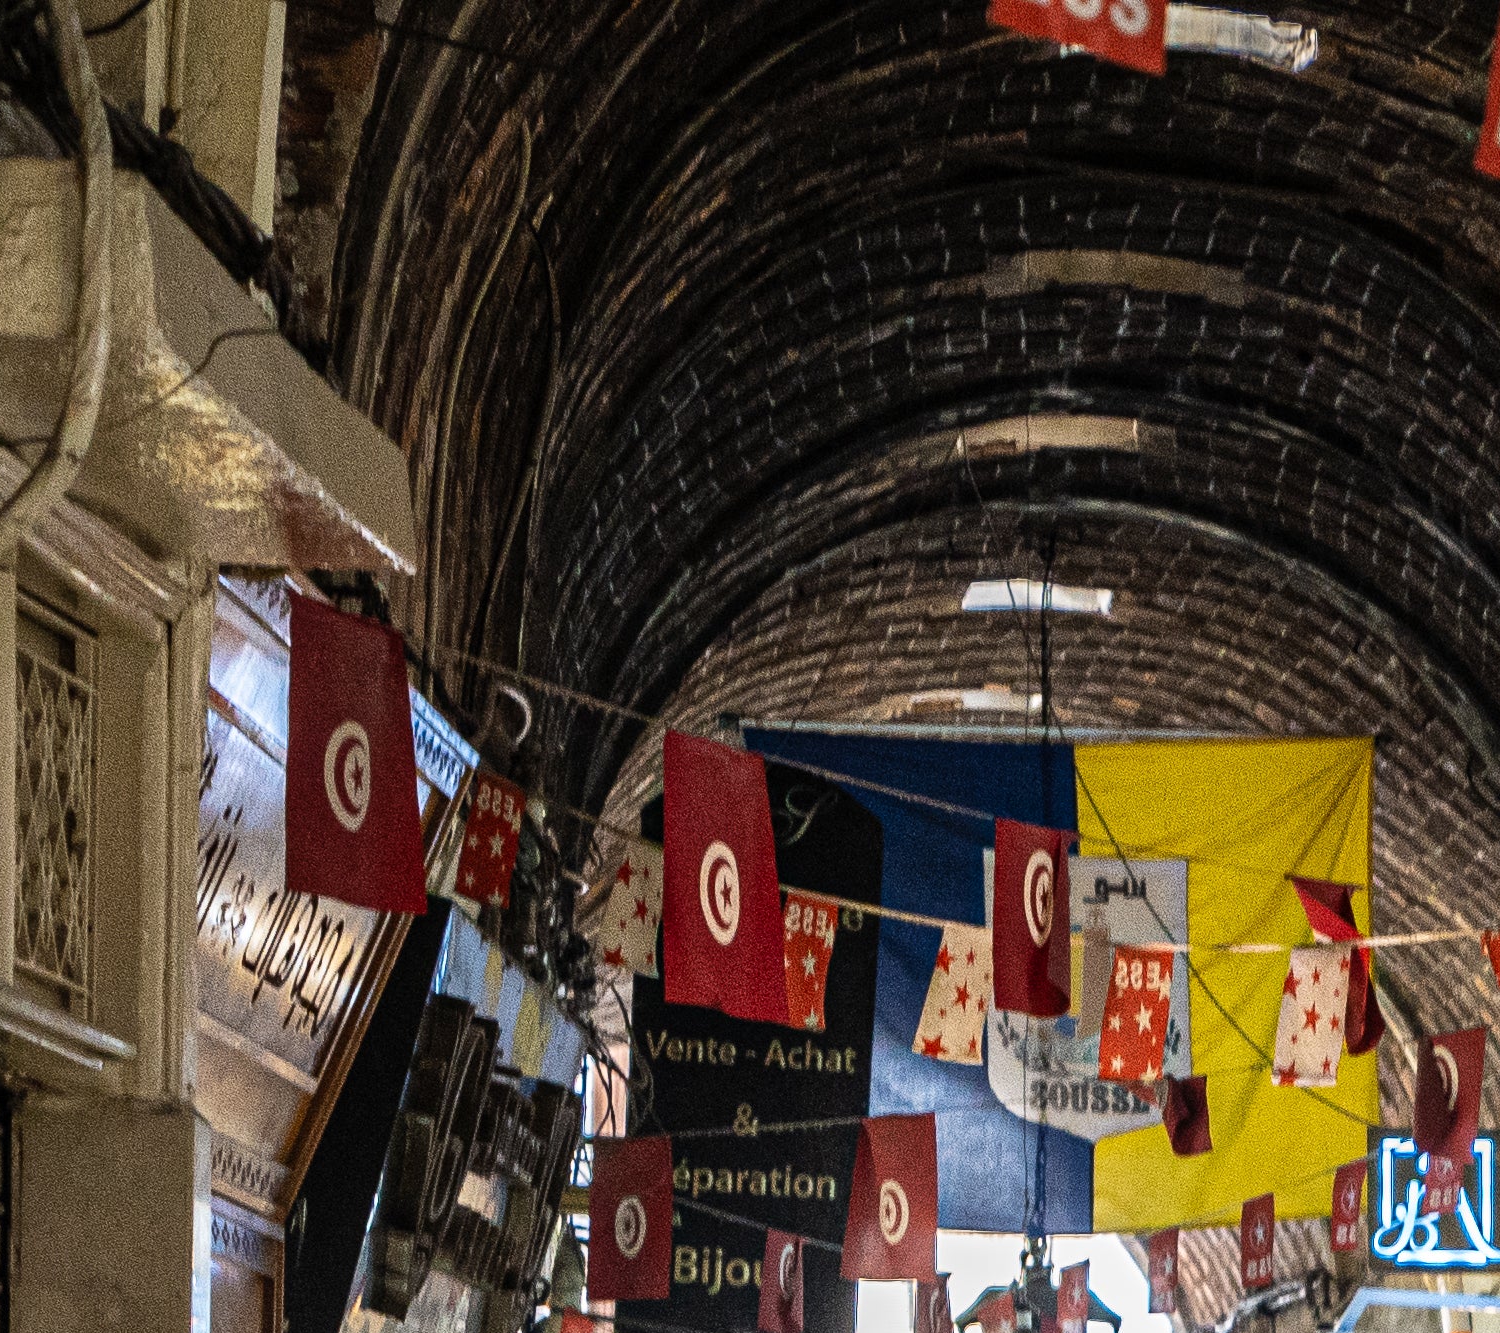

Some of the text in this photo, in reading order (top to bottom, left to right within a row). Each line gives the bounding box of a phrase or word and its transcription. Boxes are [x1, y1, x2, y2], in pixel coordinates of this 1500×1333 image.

[646, 1031, 738, 1065] Vente
[764, 1037, 857, 1074] Achat
[733, 1102, 760, 1138] &
[673, 1157, 838, 1199] éparation
